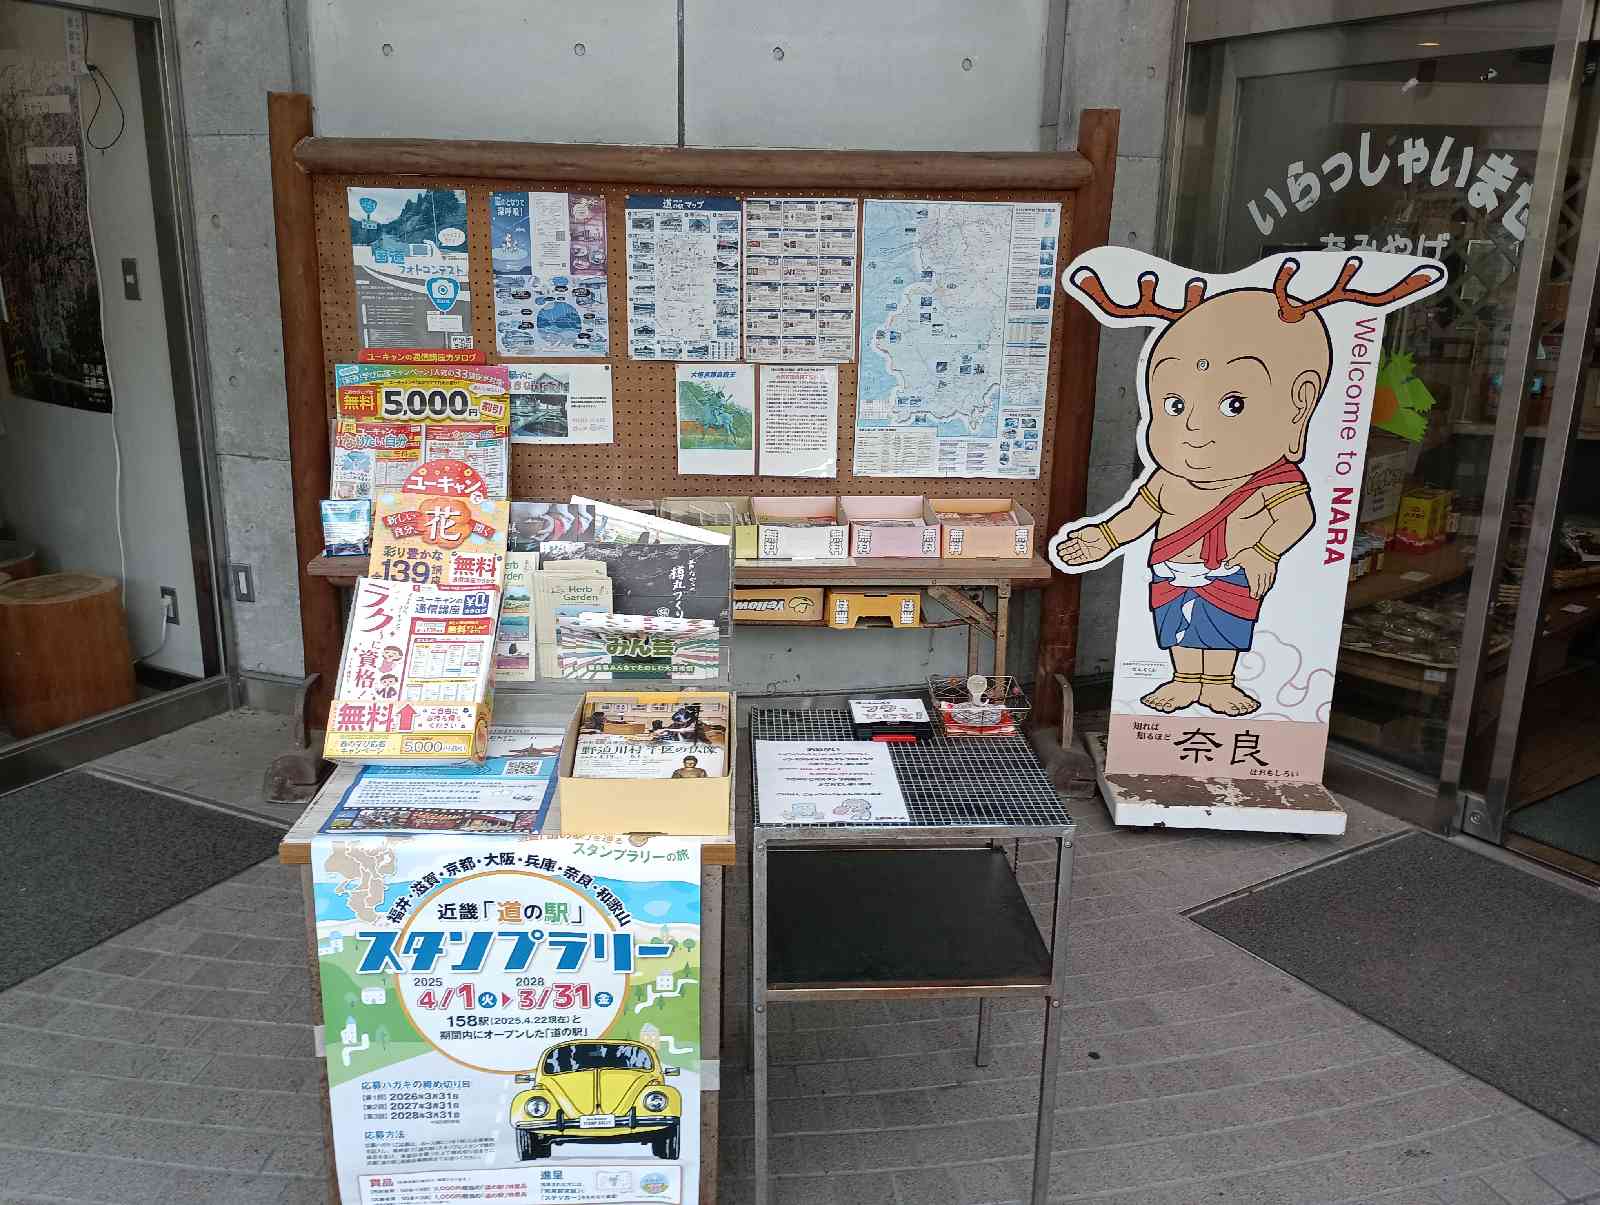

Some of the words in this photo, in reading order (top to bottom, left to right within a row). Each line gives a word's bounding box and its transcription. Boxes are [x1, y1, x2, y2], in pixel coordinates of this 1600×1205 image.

[1340, 317, 1378, 440] Welcome
[1335, 450, 1358, 476] to
[407, 475, 482, 495] ユーキャン
[423, 506, 462, 542] 花
[1323, 487, 1354, 565] NARA
[383, 546, 444, 560] 彩り豊かな
[382, 559, 431, 584] 139
[453, 556, 497, 578] 無料
[569, 585, 592, 593] Herb
[337, 703, 395, 733] 無料
[1173, 727, 1270, 768] 奈良
[571, 842, 691, 864] スタンプラリーの旅
[437, 901, 584, 926] 近畿「道の駅」
[357, 931, 674, 974] スタンプラリー
[414, 977, 443, 987] 2025
[515, 977, 545, 987] 2028
[417, 982, 476, 1010] 4/1
[518, 983, 592, 1010] 3/31
[361, 1080, 471, 1090] 応募ハガキの締め切り日
[364, 1130, 404, 1140] 応募方法
